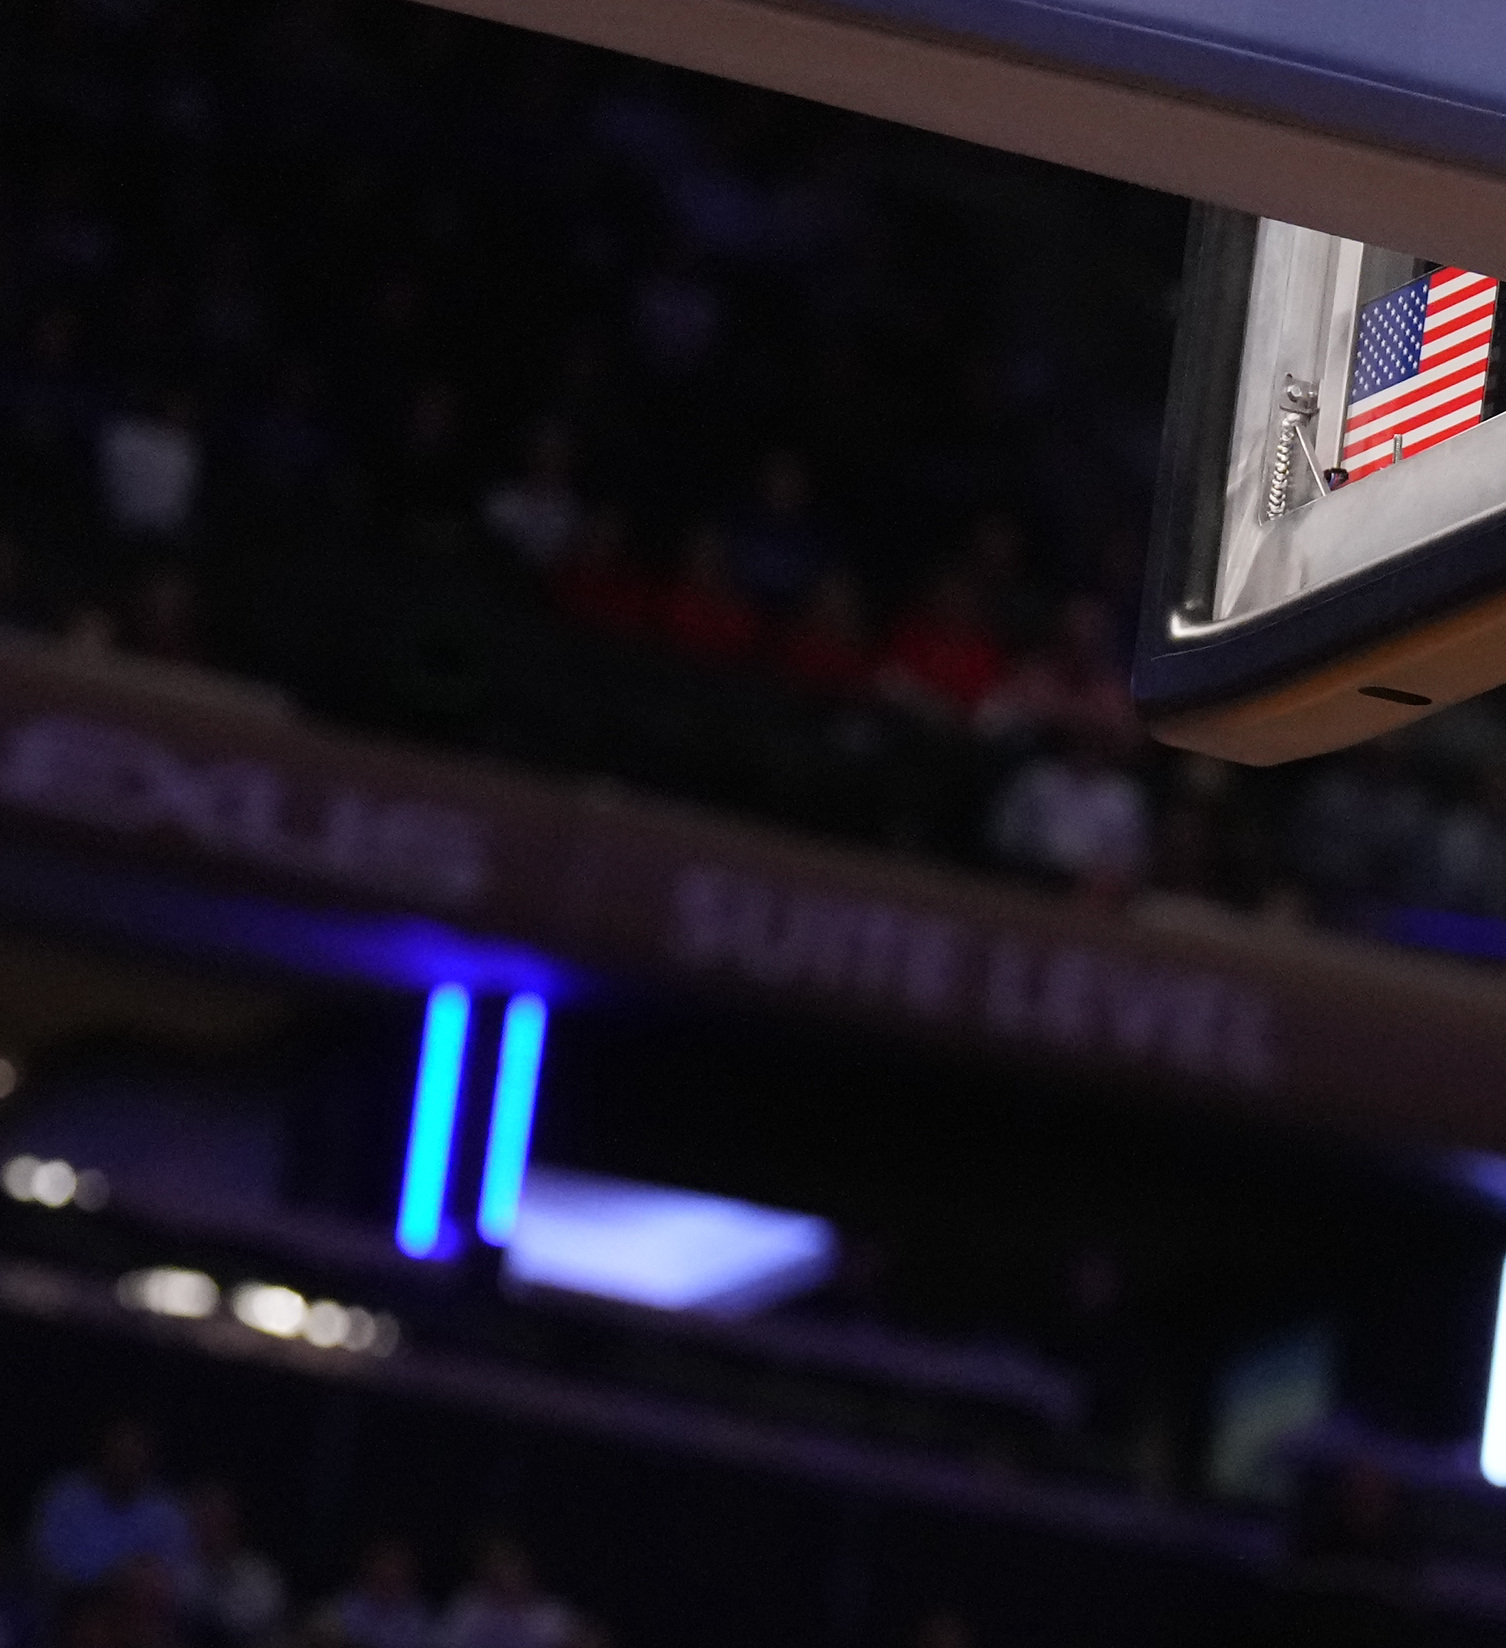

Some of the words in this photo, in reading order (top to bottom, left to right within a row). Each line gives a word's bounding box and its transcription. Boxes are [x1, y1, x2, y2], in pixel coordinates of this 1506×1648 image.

[0, 713, 488, 905] EXUS
[668, 864, 962, 1015] SUITE
[982, 930, 1284, 1092] LEVEL
